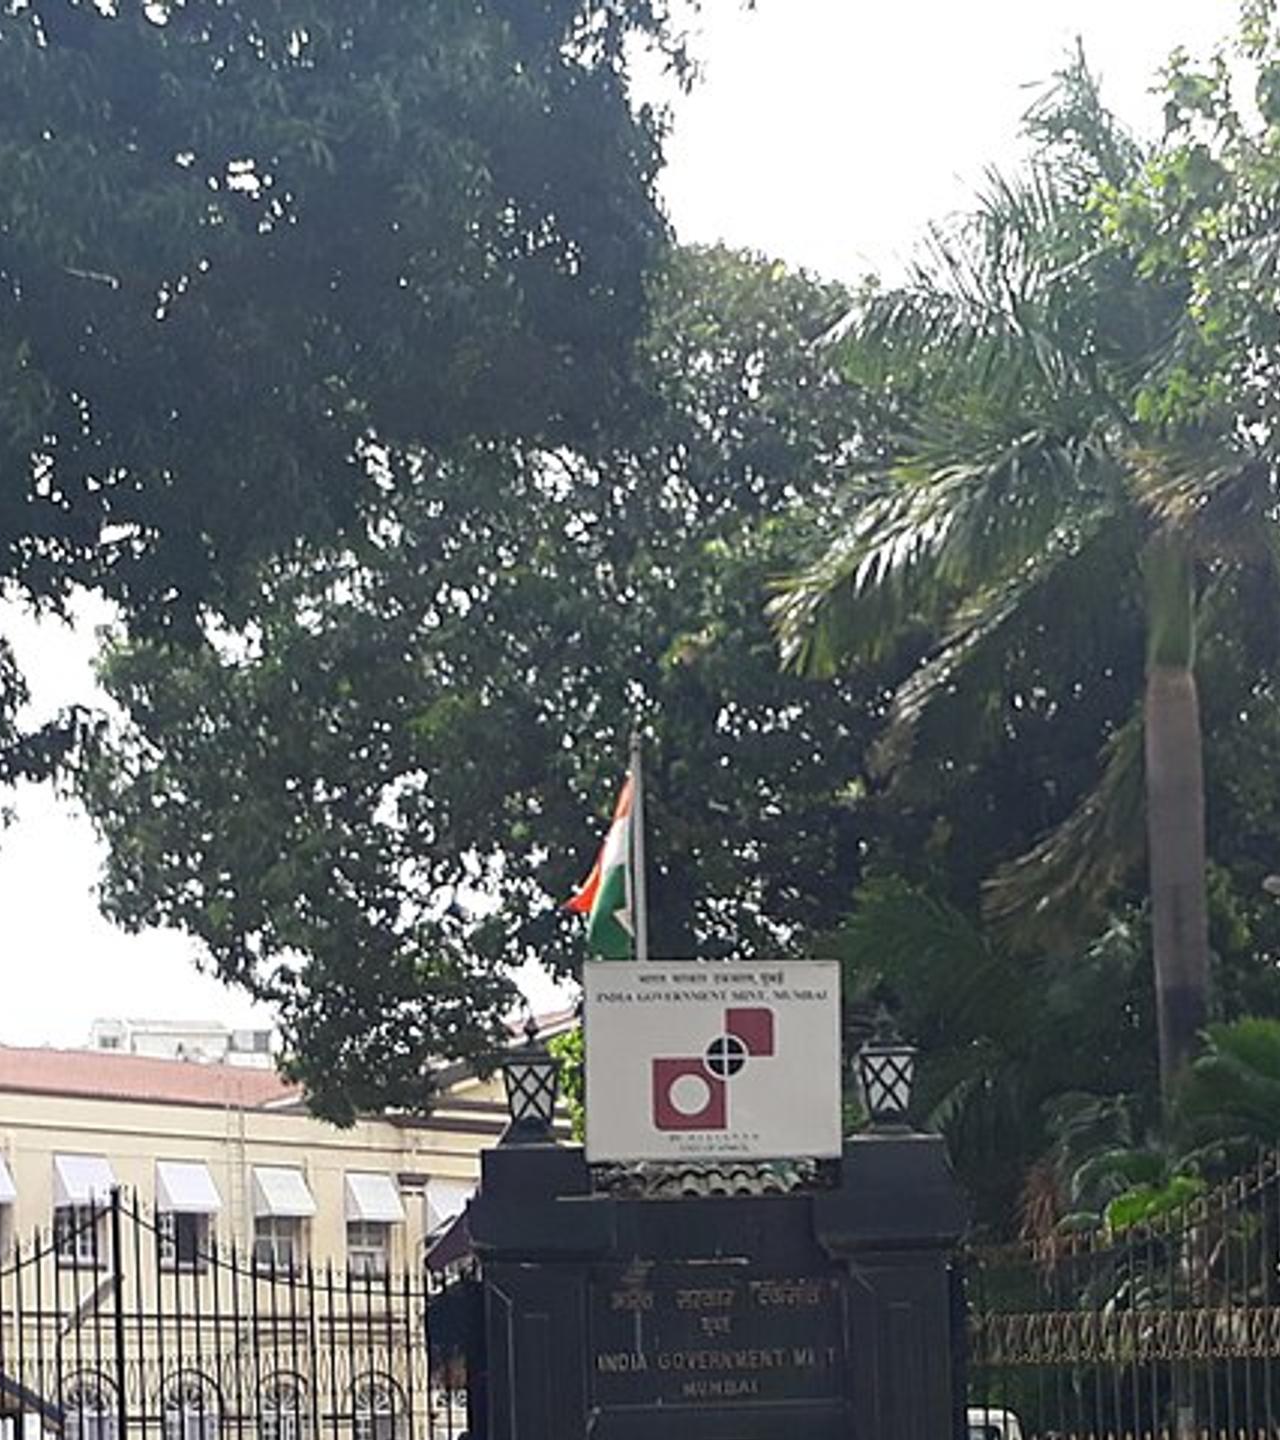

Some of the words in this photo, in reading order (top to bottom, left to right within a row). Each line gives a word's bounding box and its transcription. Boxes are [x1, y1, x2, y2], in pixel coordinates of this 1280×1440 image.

[597, 1352, 648, 1373] INDIA
[657, 1348, 785, 1372] GOVERNMENT
[793, 1347, 835, 1367] MIT
[682, 1378, 759, 1398] MUMBAI
